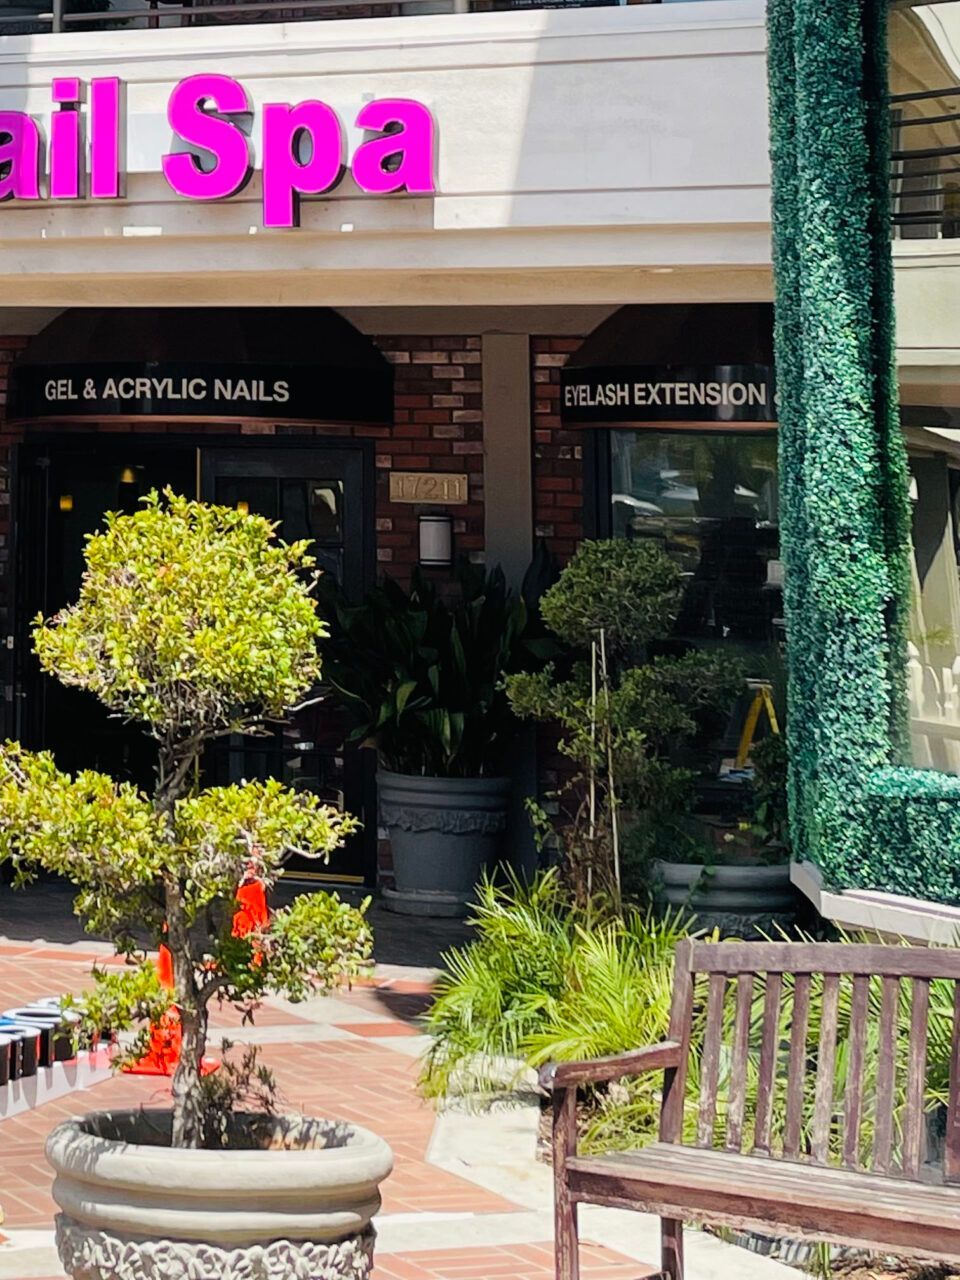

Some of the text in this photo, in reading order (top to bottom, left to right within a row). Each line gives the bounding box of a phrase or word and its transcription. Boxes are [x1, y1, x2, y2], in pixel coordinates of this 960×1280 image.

[161, 73, 437, 228] Spa
[45, 377, 290, 402] GEL & ACRYLIC NAILS
[564, 383, 630, 407] EYELASH
[634, 382, 766, 406] EXTENSION
[397, 476, 463, 500] 17211
